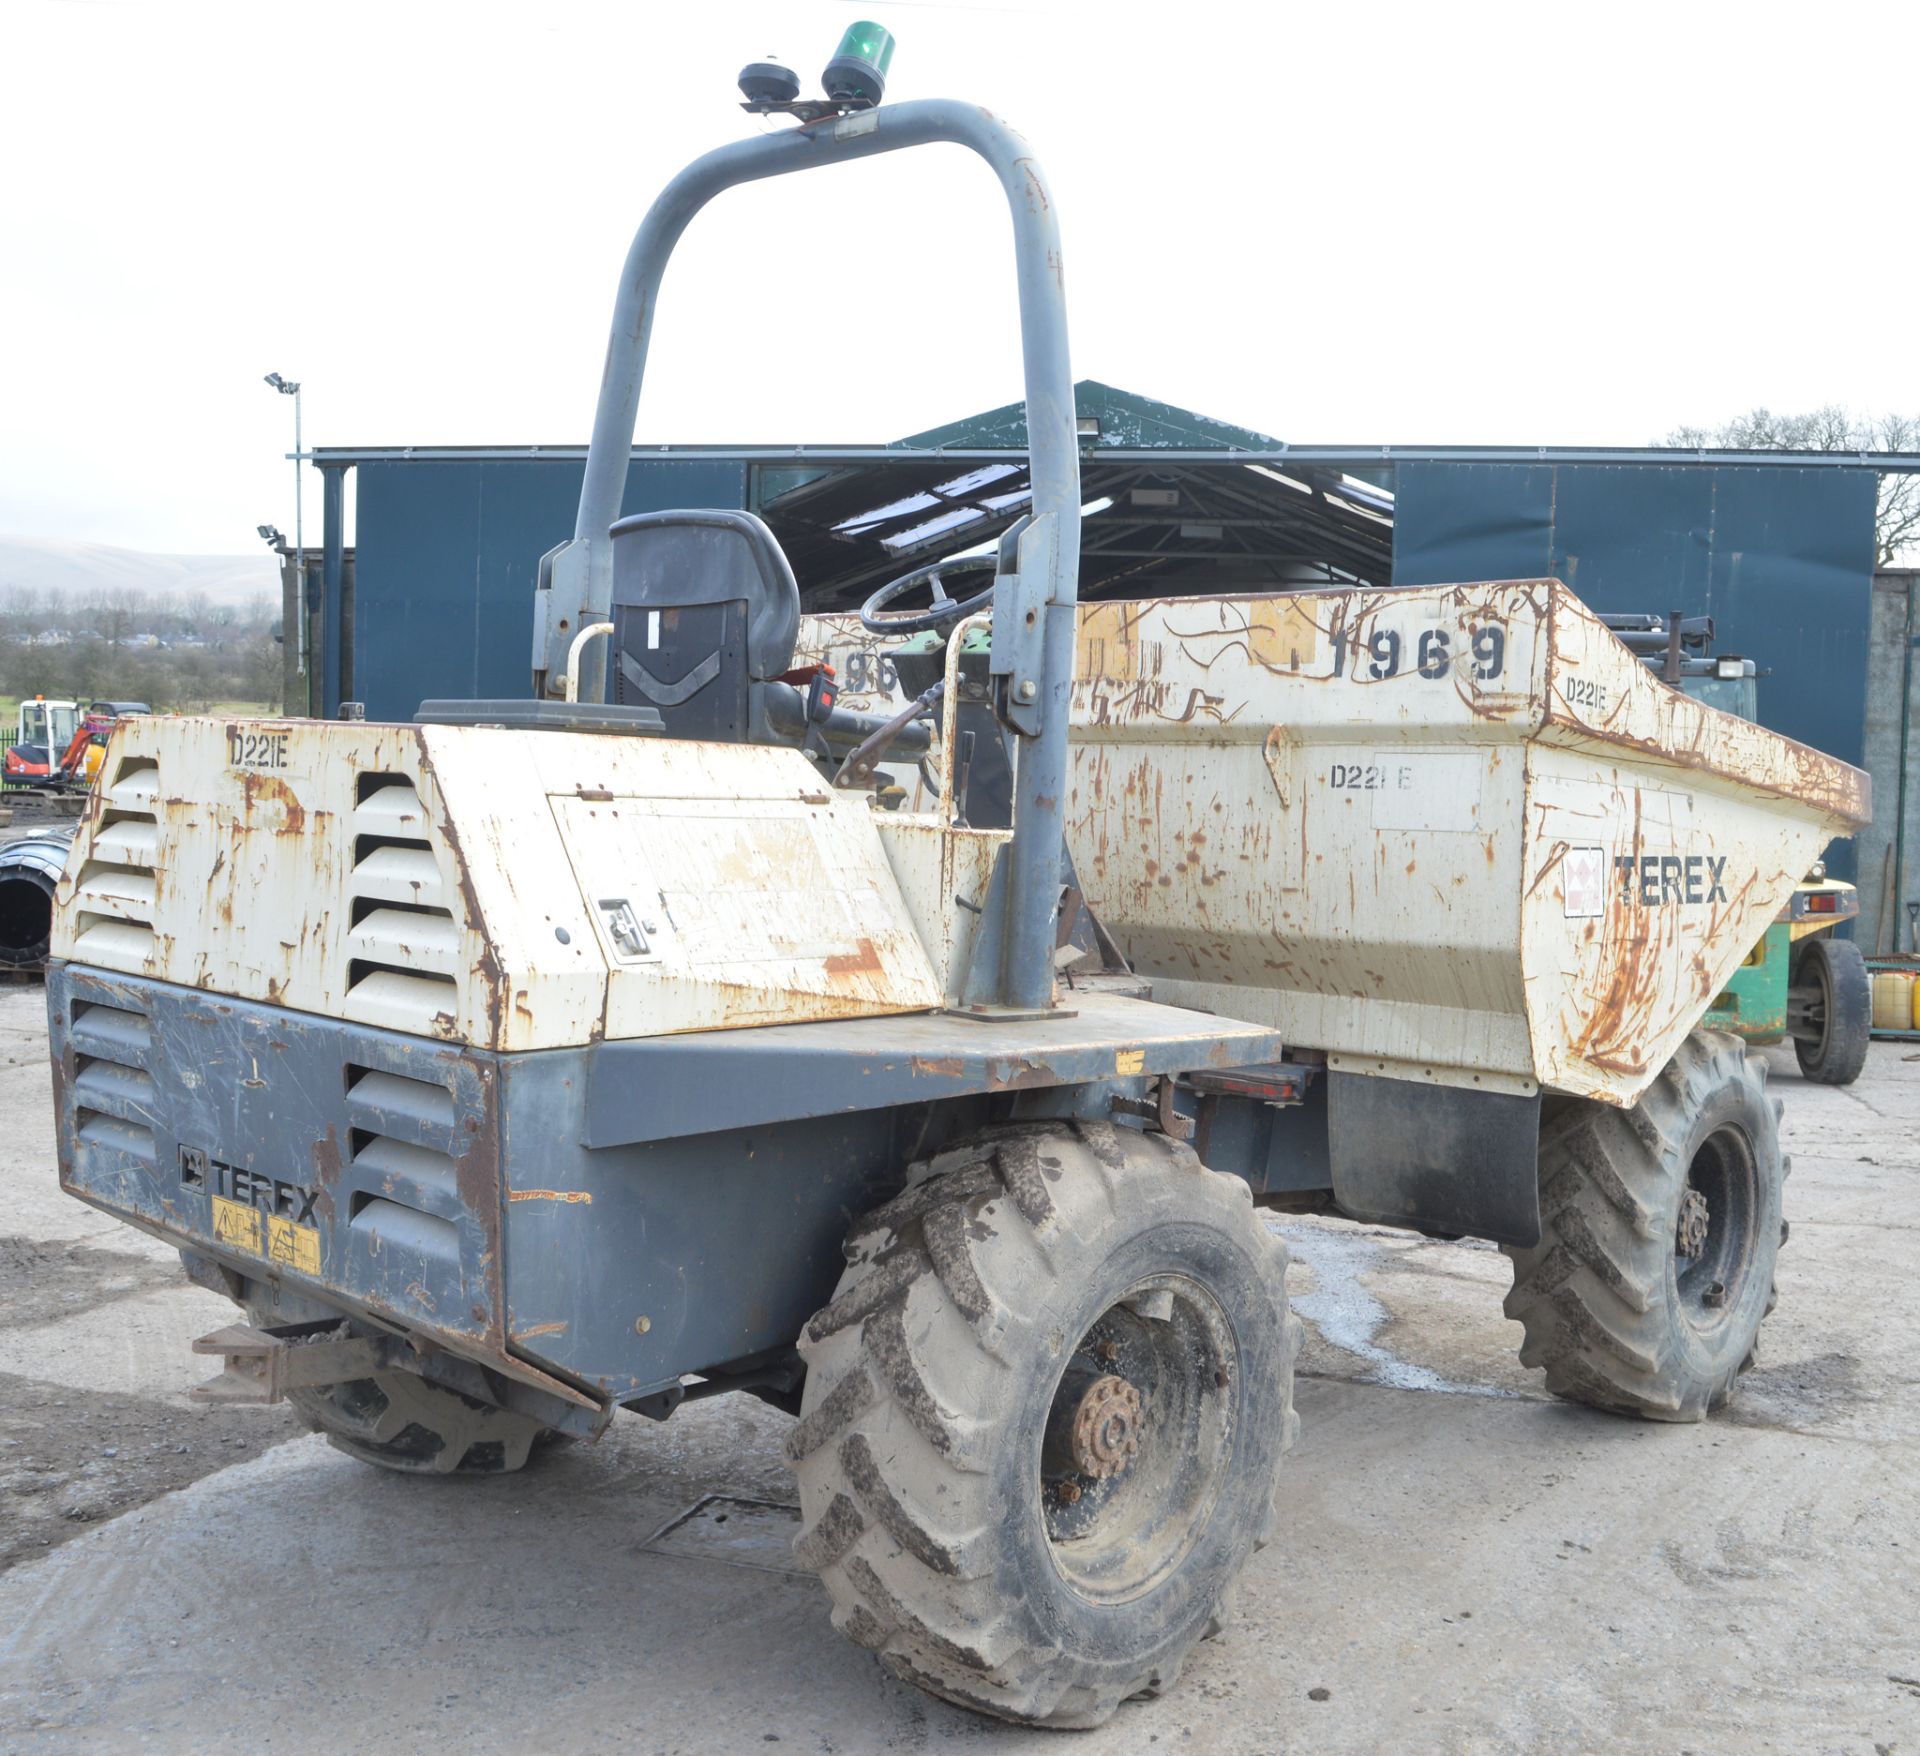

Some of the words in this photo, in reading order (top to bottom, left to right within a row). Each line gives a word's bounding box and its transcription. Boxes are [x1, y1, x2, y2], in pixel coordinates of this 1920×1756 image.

[1330, 627, 1505, 680] 1969
[1615, 856, 1728, 907] TEREX
[211, 1159, 320, 1230] TEREX
